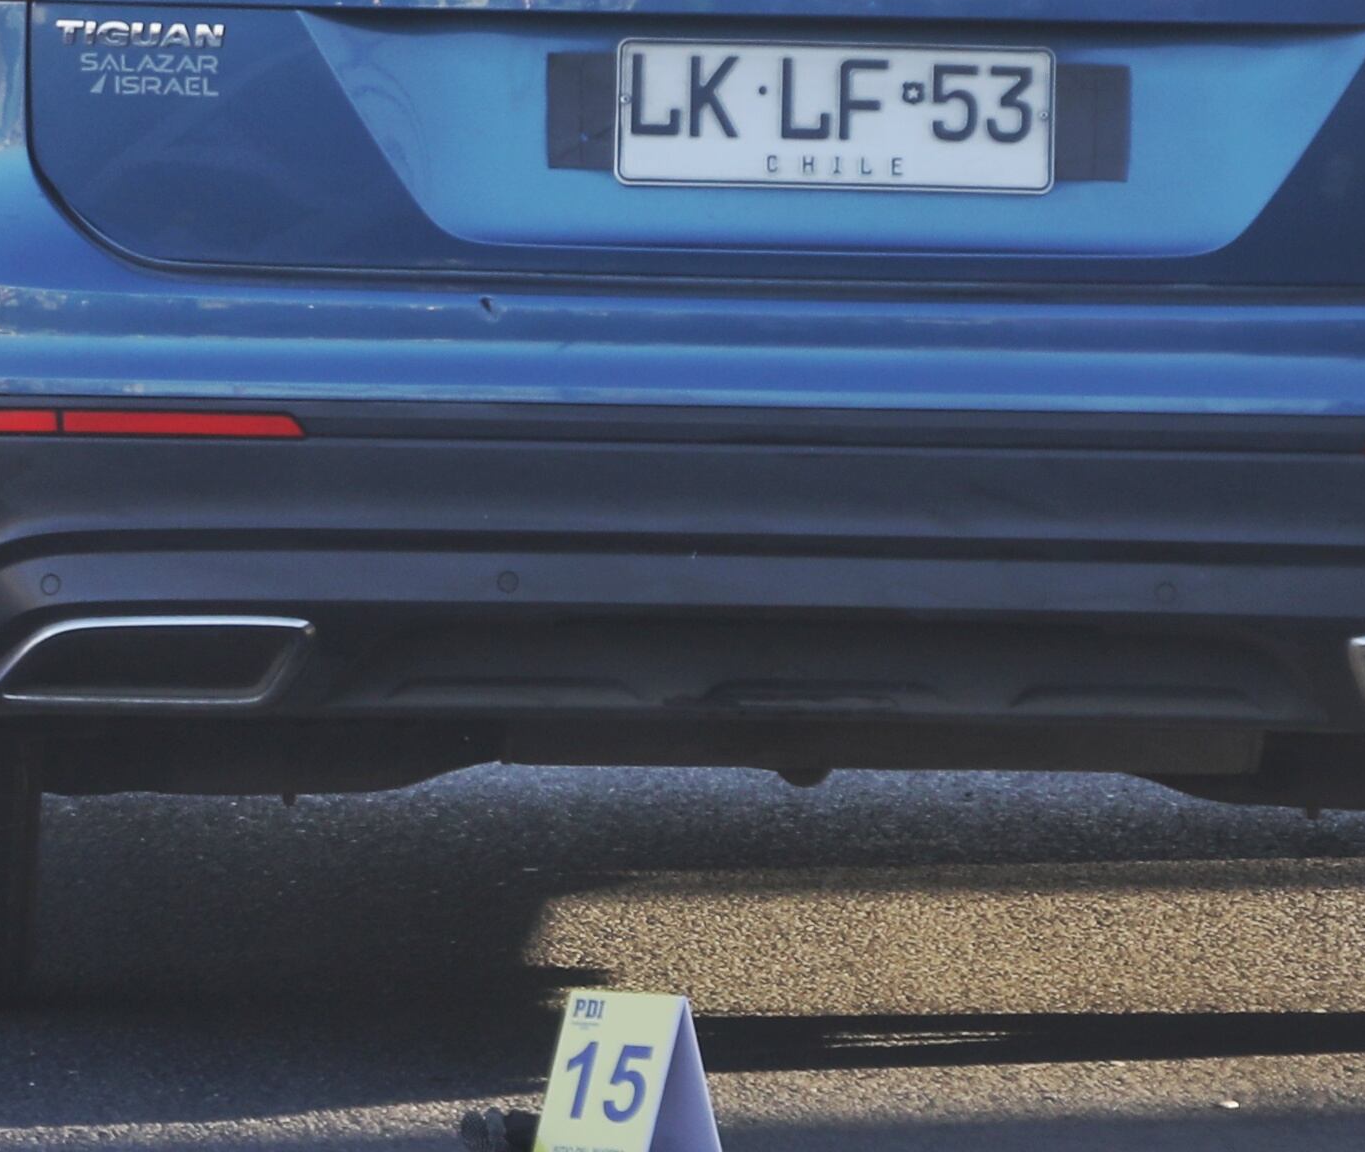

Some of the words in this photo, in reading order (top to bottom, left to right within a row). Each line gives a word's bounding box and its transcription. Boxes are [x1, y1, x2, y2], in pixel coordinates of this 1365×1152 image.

[56, 20, 225, 48] TIGUAN
[80, 52, 219, 73] SALAZAR
[114, 76, 219, 96] ISRAEL
[766, 154, 905, 176] CHILE
[572, 999, 606, 1020] PDI
[567, 1041, 653, 1123] 15
